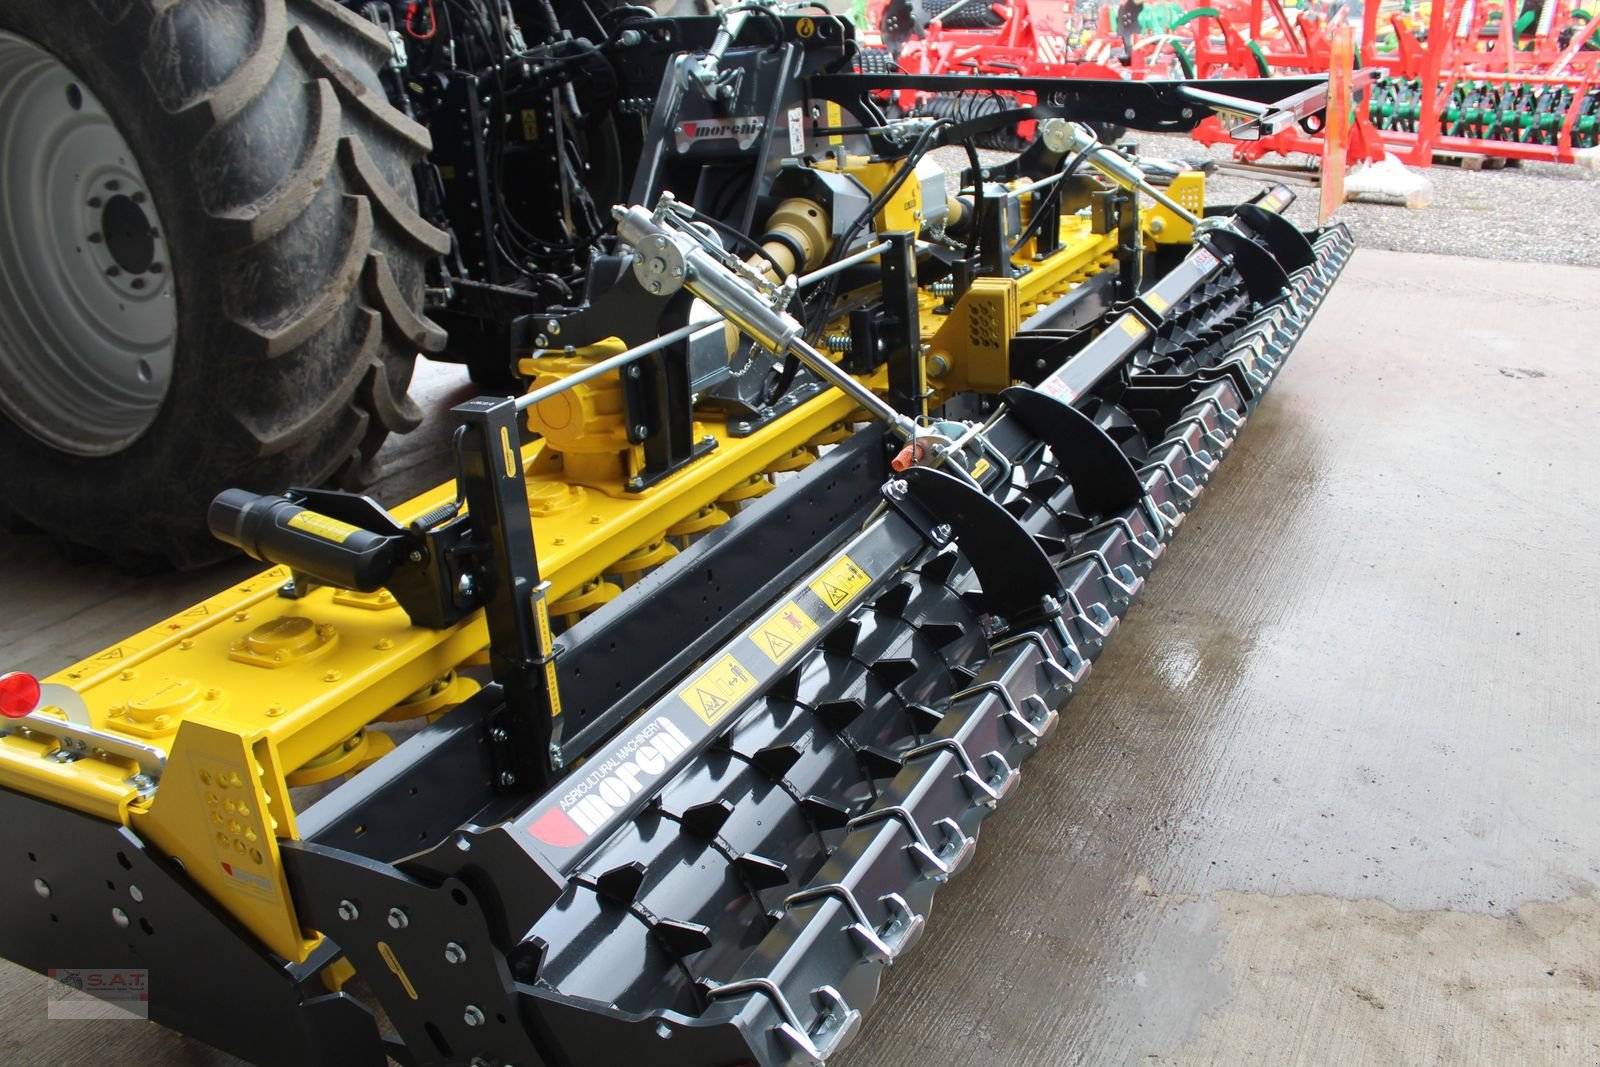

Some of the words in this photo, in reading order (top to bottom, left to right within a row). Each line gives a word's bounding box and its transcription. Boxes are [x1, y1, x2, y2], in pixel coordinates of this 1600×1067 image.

[695, 119, 757, 137] moreni
[559, 758, 619, 811] AGRICULTURAL
[618, 720, 661, 761] MACHINERY
[567, 717, 692, 836] moreni
